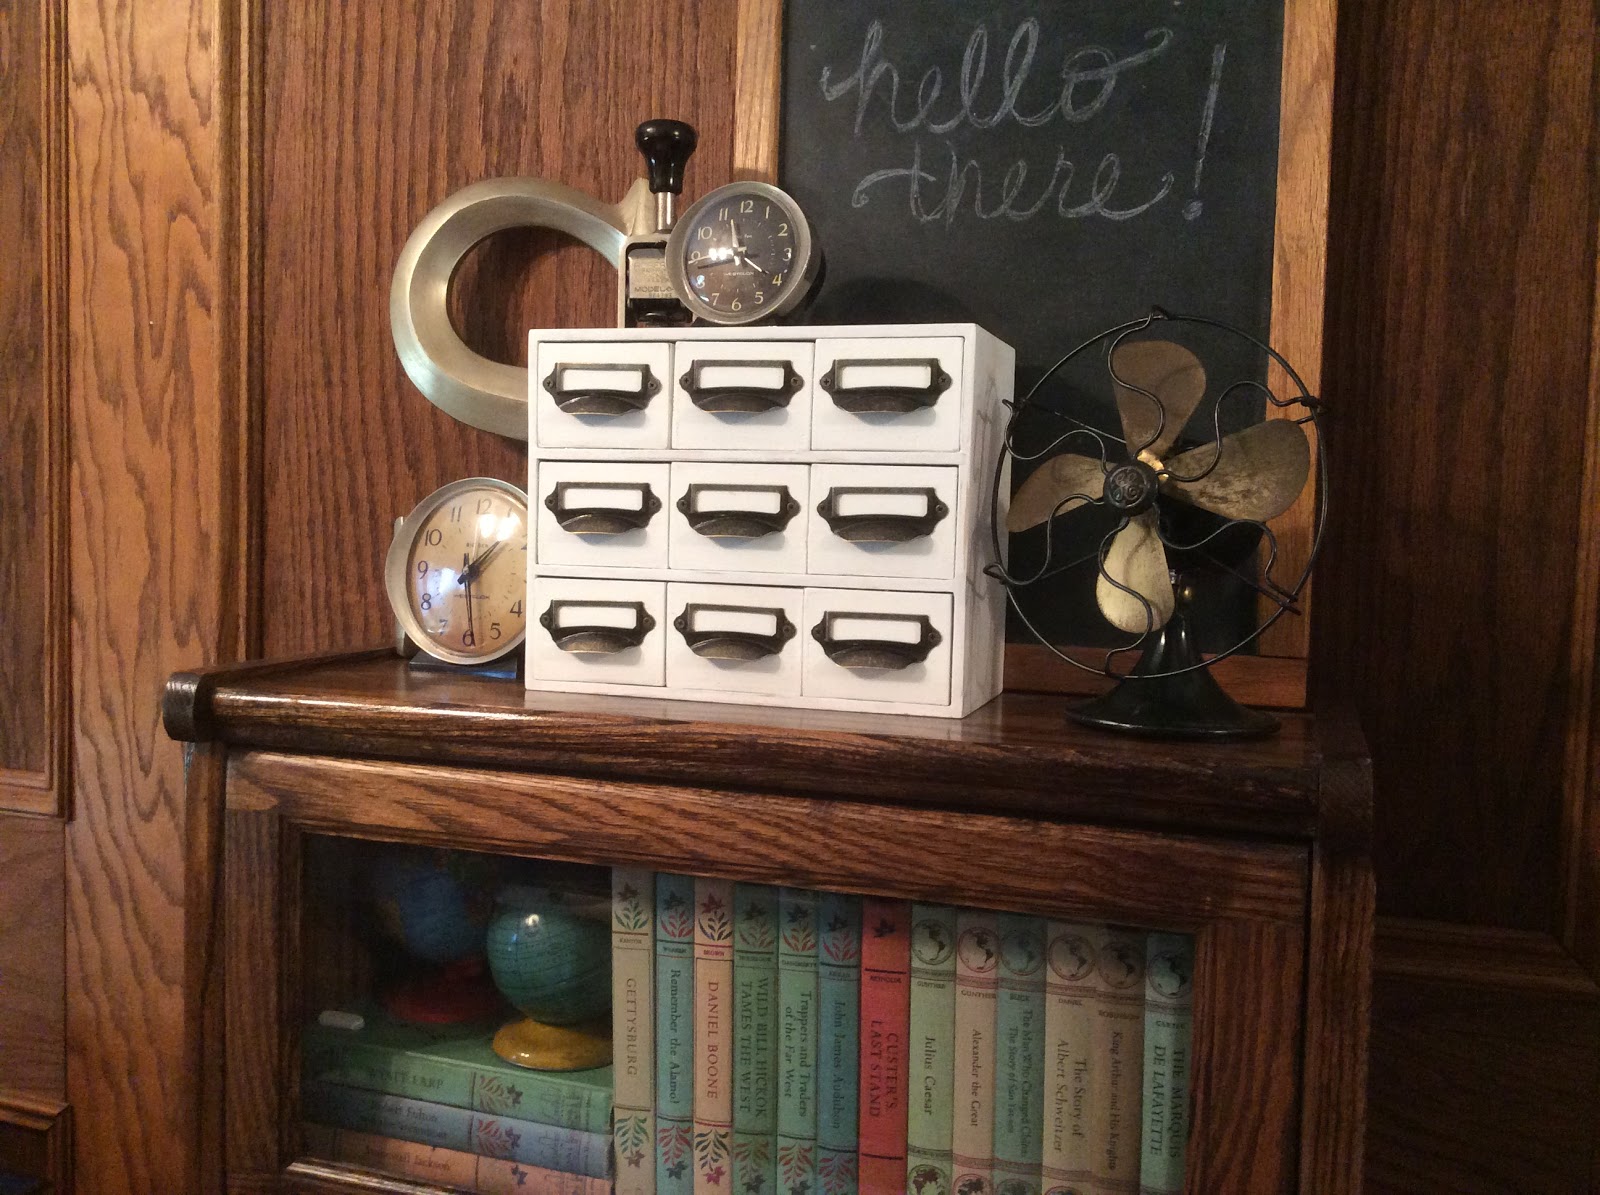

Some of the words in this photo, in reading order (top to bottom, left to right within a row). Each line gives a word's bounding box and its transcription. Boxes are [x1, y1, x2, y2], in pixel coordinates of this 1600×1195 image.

[820, 16, 1174, 137] hello
[718, 207, 729, 221] 11
[739, 199, 755, 214] 12
[764, 205, 770, 219] 1
[697, 226, 713, 240] 10
[777, 223, 788, 237] 2
[782, 247, 792, 260] 3
[695, 274, 705, 289] 8
[771, 272, 783, 287] 4
[710, 292, 720, 307] 7
[731, 297, 742, 311] 6
[754, 291, 764, 305] 5
[450, 506, 462, 523] 11
[476, 498, 493, 515] 12
[424, 528, 443, 547] 10
[417, 560, 429, 580] 9
[420, 592, 432, 611] 8
[509, 599, 523, 618] 4
[489, 622, 502, 640] 5
[668, 968, 681, 1033] Remember
[706, 981, 720, 1038] DANIEL
[740, 981, 753, 1031] TAMES
[755, 977, 769, 1016] WILD
[625, 977, 639, 1076] GETTYSBURG
[784, 1006, 796, 1020] of
[798, 990, 812, 1043] Trappers
[833, 1000, 847, 1027] John
[1022, 1009, 1033, 1030] The
[755, 1022, 769, 1055] BILL
[784, 1023, 796, 1042] the
[870, 1019, 883, 1059] LAST
[1008, 1026, 1019, 1045] The
[1021, 1030, 1032, 1053] Man
[1109, 1030, 1123, 1056] King
[669, 1037, 681, 1056] the
[740, 1035, 753, 1066] THE
[784, 1045, 796, 1064] Far
[799, 1045, 811, 1067] and
[832, 1033, 846, 1068] James
[923, 1034, 936, 1070] Julius
[970, 1028, 982, 1078] Alexander
[1007, 1045, 1019, 1072] Story
[1056, 1038, 1069, 1078] Albert
[1153, 1044, 1167, 1065] DE
[705, 1044, 719, 1099] BOONE
[885, 1032, 899, 1110] CUSTER'S
[1020, 1054, 1032, 1078] Who
[1073, 1058, 1087, 1084] The
[1110, 1057, 1122, 1089] Arthur
[1172, 1048, 1186, 1078] THE
[668, 1061, 681, 1105] Alamo!
[739, 1071, 752, 1112] WEST
[754, 1060, 769, 1119] HICKOK
[784, 1070, 796, 1098] West
[799, 1074, 811, 1117] Traders
[868, 1063, 882, 1119] STAND
[923, 1075, 936, 1116] Caesar
[970, 1081, 982, 1097] the
[831, 1074, 846, 1130] Audubon
[970, 1100, 982, 1127] Great
[1019, 1079, 1032, 1124] Changed
[1070, 1087, 1086, 1120] Story
[1149, 1070, 1166, 1156] LAFAYETTE
[1053, 1084, 1067, 1153] Schweitzer
[1072, 1123, 1085, 1138] of
[1168, 1086, 1184, 1159] MARQUIS
